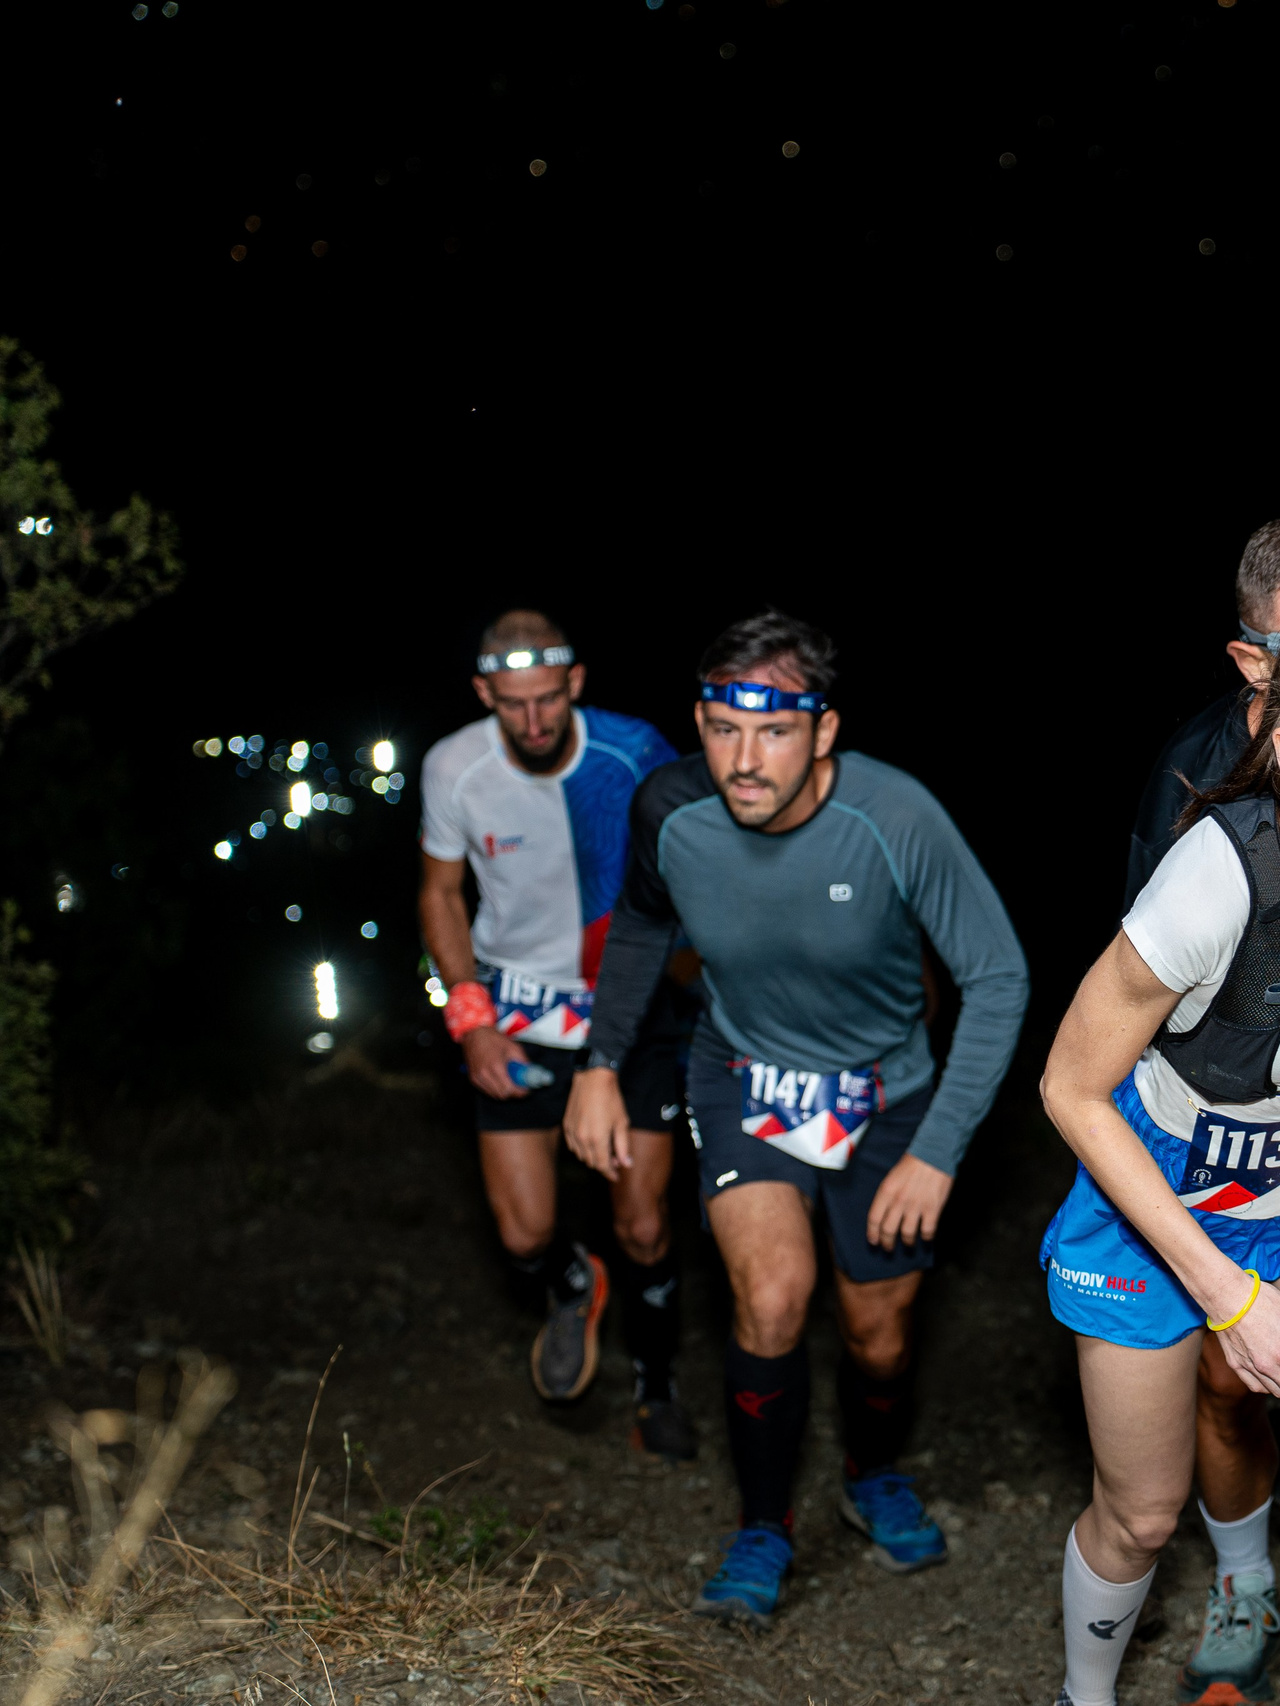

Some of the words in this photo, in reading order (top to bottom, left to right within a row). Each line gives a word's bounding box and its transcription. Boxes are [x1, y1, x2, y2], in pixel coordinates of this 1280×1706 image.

[749, 1061, 822, 1111] 1147
[1051, 1257, 1105, 1288] PLOVDIV
[1106, 1275, 1147, 1294] HILLS
[1063, 1282, 1073, 1290] IN
[1077, 1287, 1126, 1302] MARKOVO
